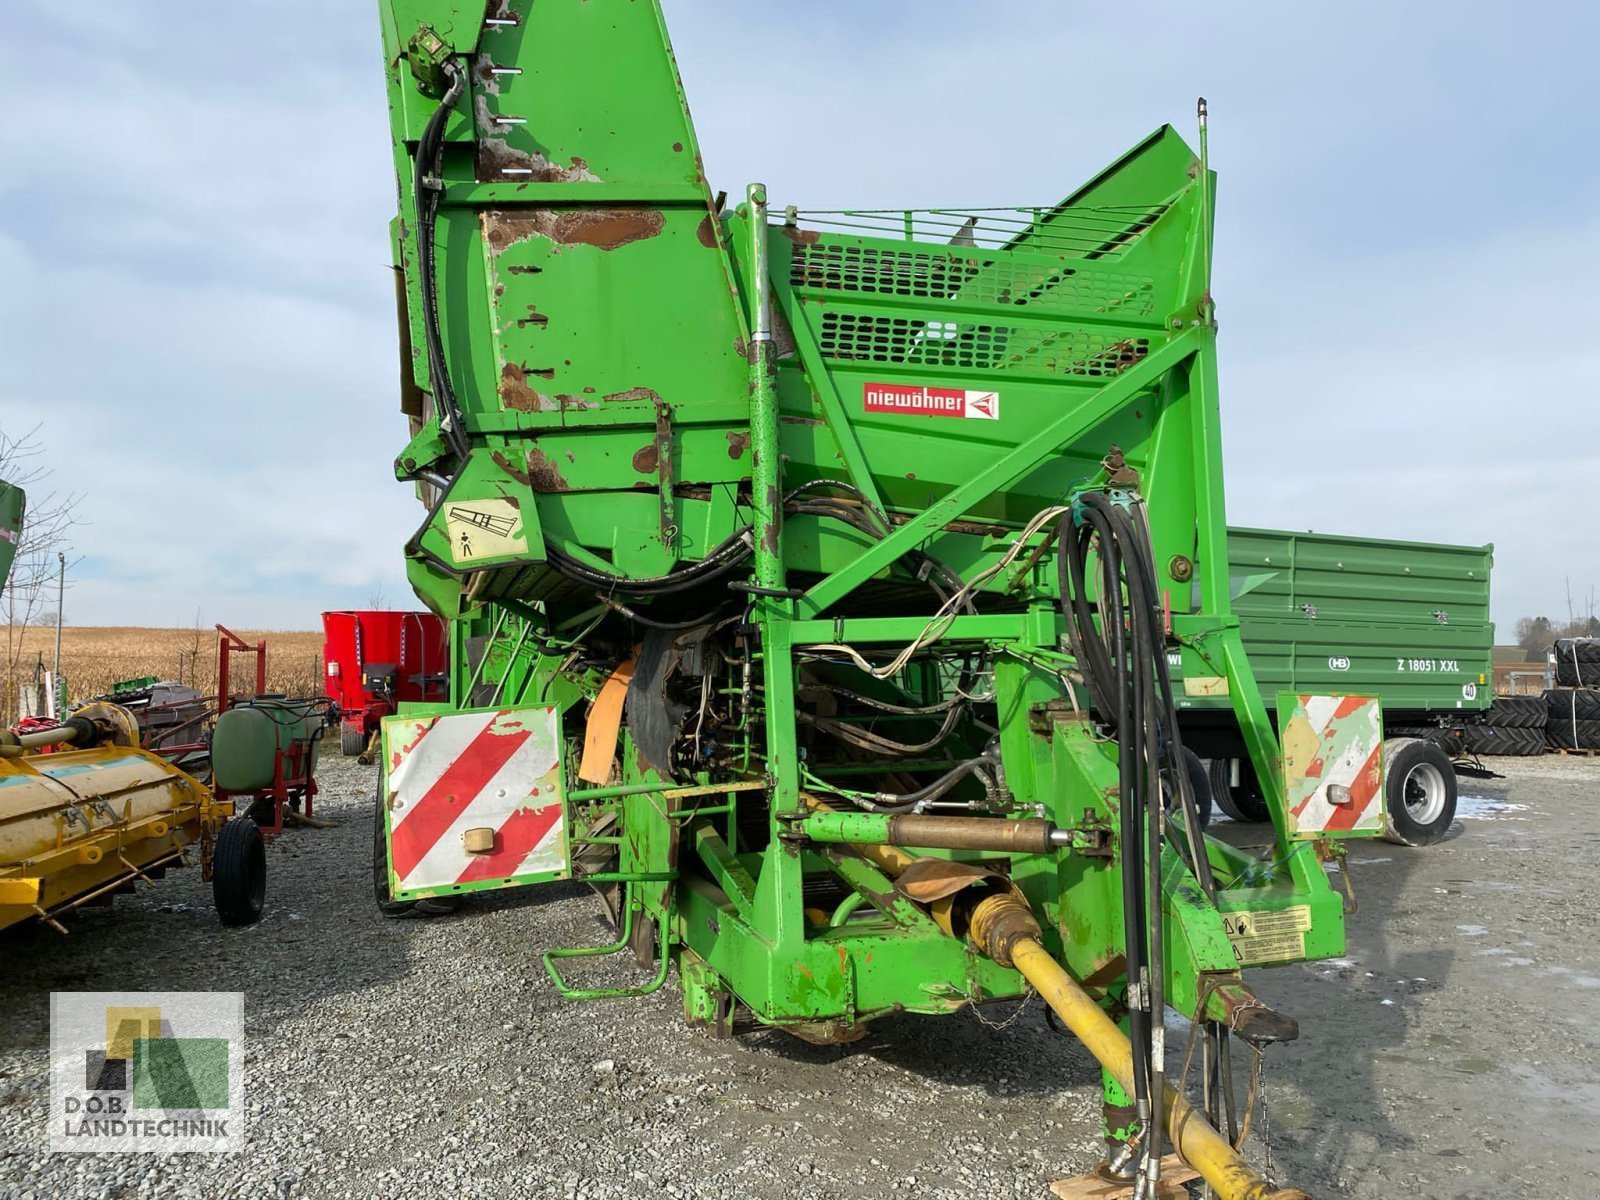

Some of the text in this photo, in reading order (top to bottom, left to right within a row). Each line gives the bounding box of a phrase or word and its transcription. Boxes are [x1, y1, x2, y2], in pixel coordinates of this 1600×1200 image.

[867, 387, 963, 411] niewöhner
[1397, 659, 1459, 672] Z 18051 XXL
[1464, 684, 1474, 698] 40
